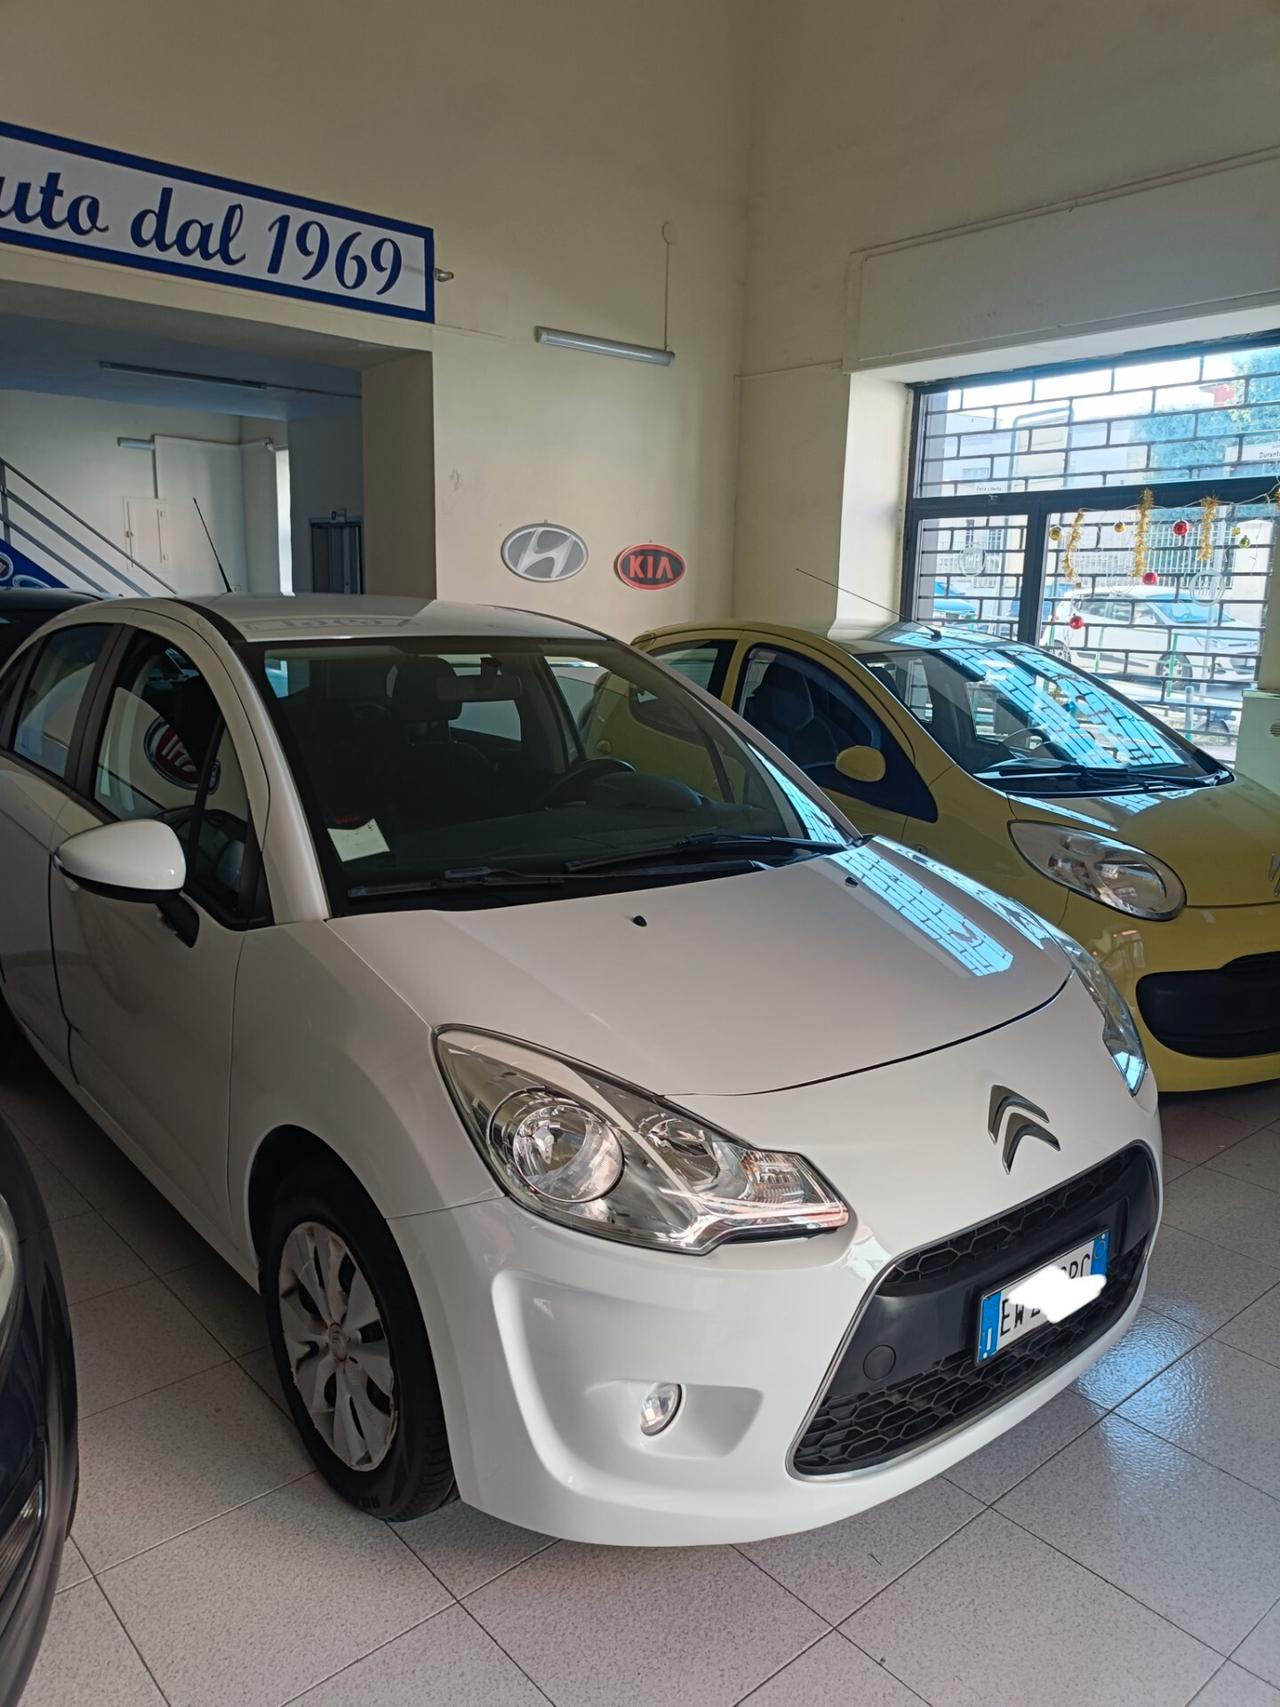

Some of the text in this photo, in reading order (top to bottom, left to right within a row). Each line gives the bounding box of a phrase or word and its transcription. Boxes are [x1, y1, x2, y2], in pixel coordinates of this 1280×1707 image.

[130, 187, 246, 265] dal
[267, 214, 402, 295] 1969
[628, 555, 673, 579] KIA
